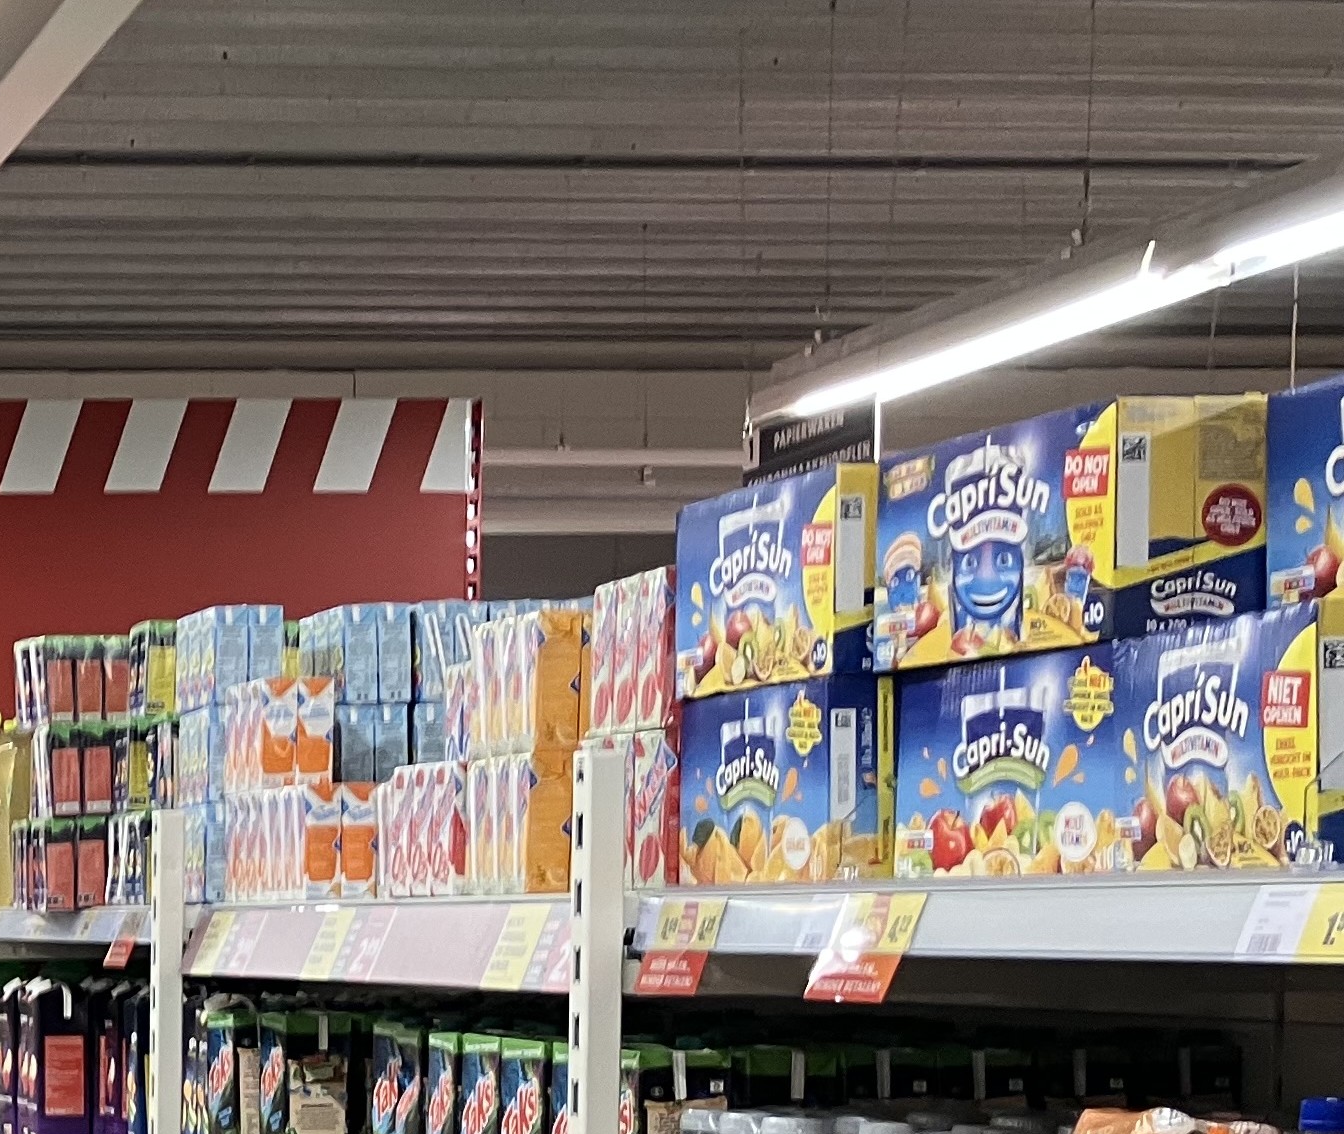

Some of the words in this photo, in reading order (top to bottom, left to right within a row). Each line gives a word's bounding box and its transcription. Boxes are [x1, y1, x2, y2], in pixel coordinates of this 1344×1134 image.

[1065, 455, 1082, 475] DO
[1086, 454, 1110, 475] NOT
[1267, 676, 1302, 704] NIET
